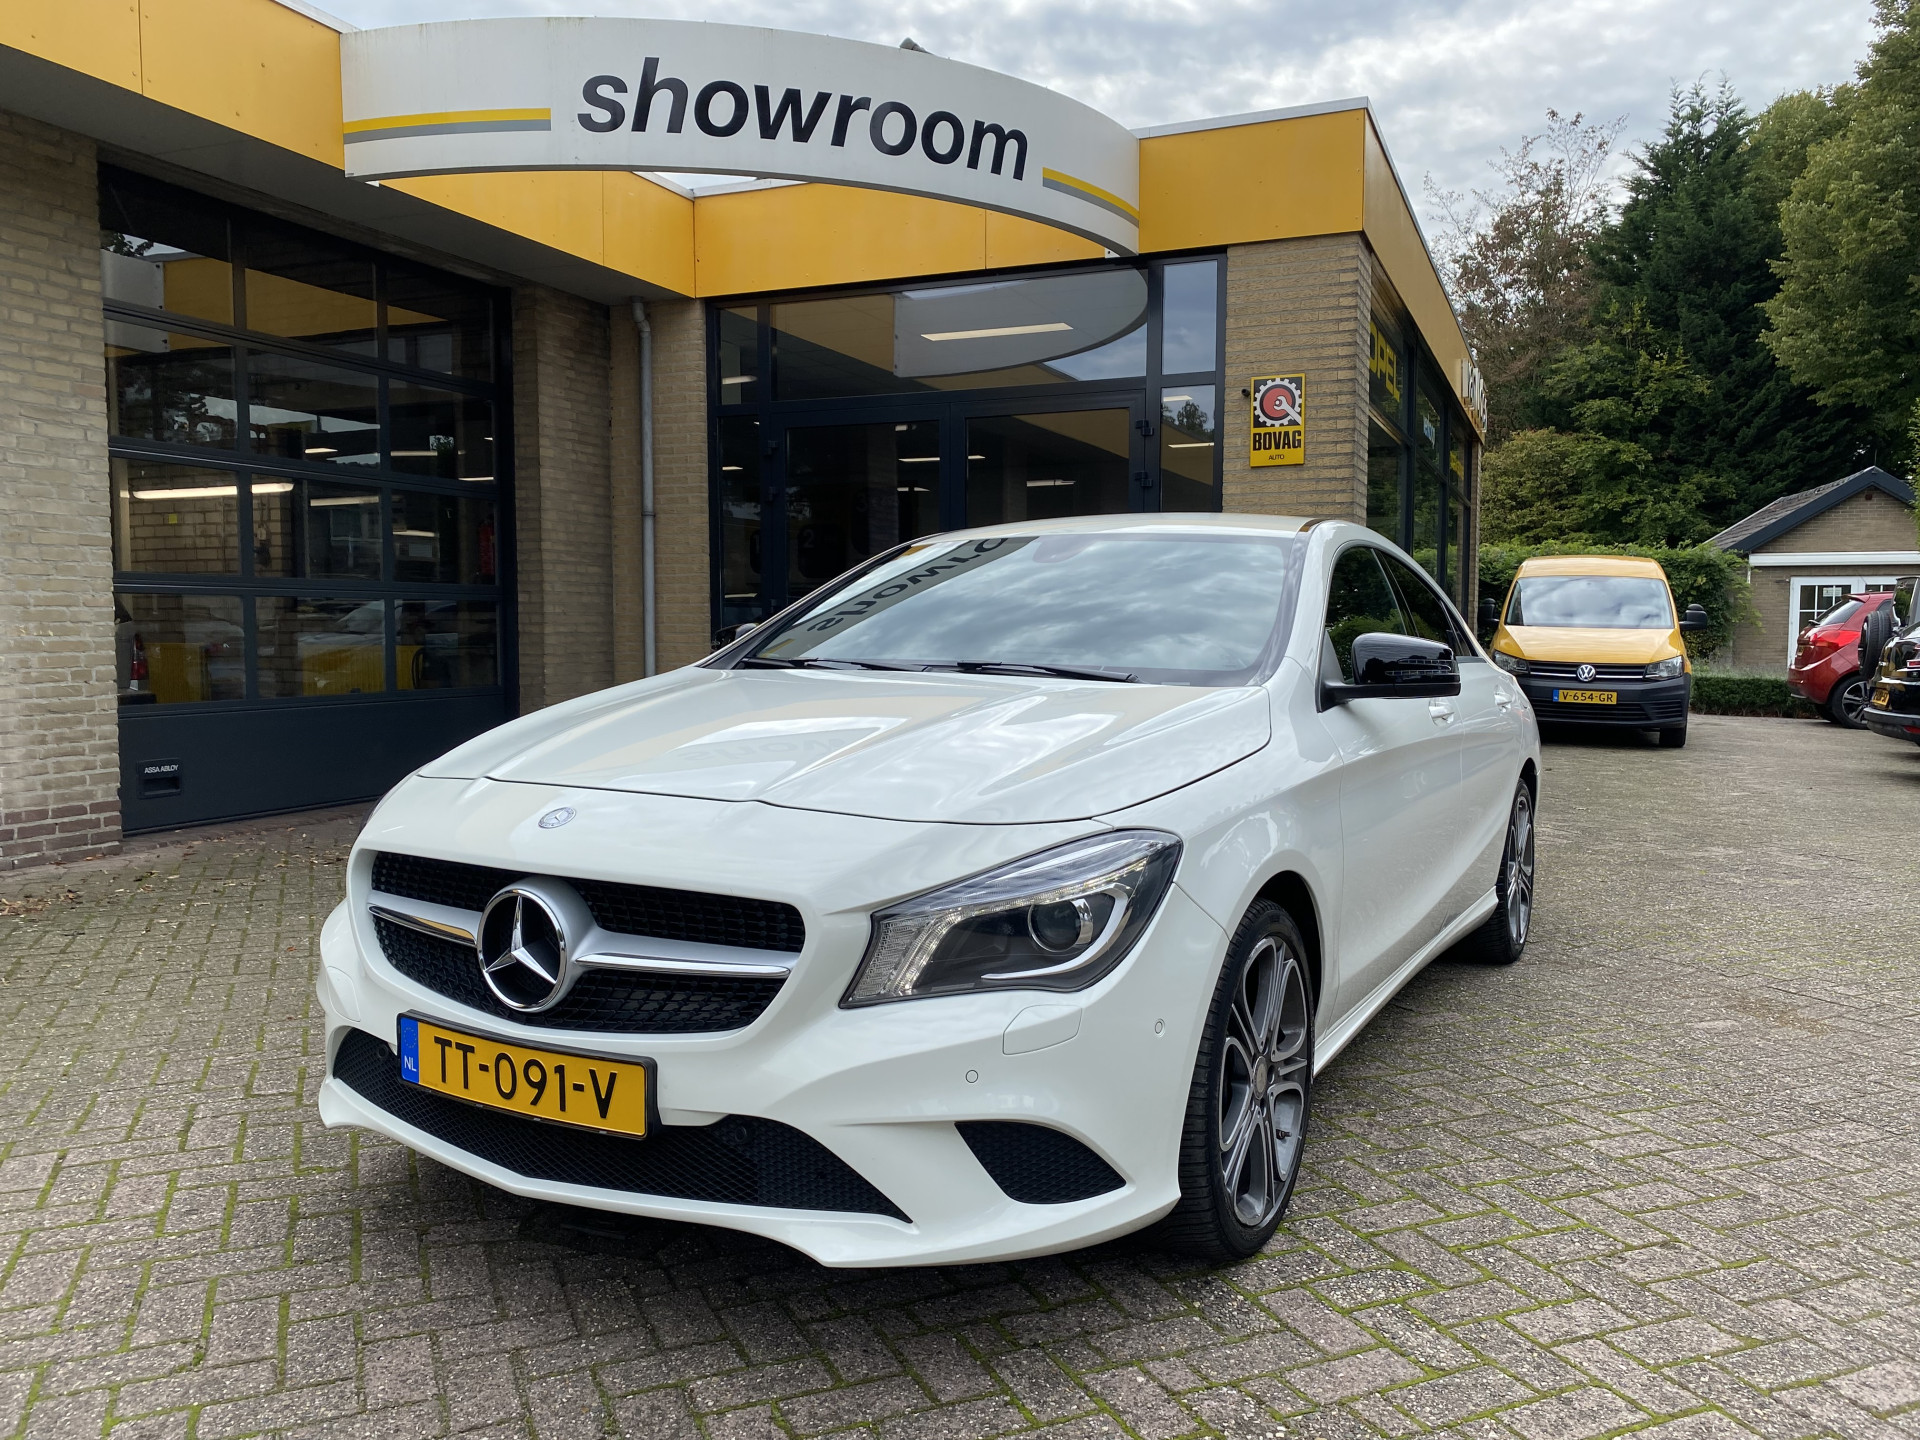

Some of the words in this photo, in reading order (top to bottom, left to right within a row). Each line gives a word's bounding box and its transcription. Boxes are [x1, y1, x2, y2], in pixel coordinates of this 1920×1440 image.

[577, 57, 1028, 181] showroom
[1369, 320, 1400, 402] OPEL
[1252, 430, 1302, 451] BOVAG
[1562, 691, 1613, 702] V-654-GR
[144, 766, 160, 774] ASSA
[161, 764, 178, 772] ABLOY
[404, 1055, 417, 1072] NL
[434, 1035, 617, 1119] TT-091-V
